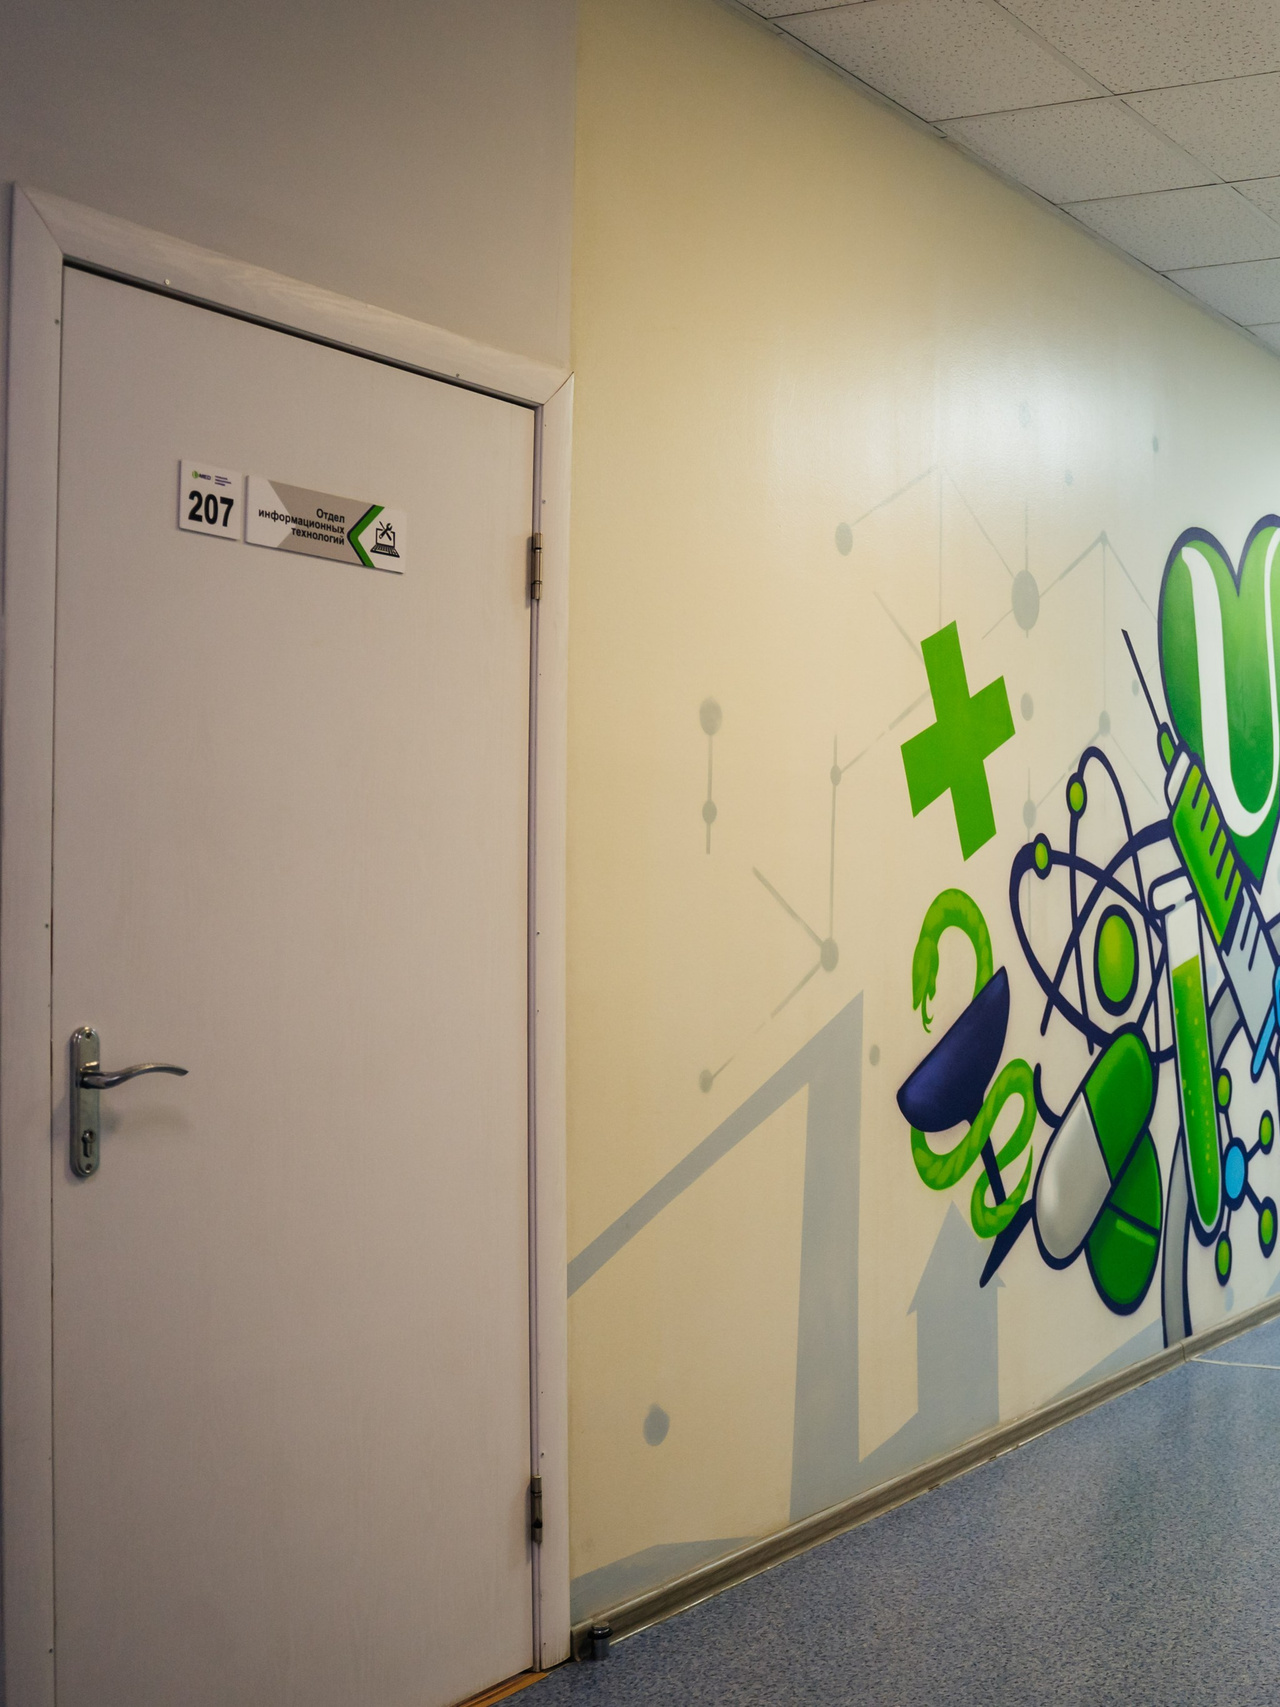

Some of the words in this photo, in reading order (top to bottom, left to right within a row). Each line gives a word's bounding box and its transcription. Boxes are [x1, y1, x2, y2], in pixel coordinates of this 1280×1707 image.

[188, 490, 234, 527] 207
[316, 508, 345, 523] Отдел
[258, 509, 345, 534] информационных
[291, 527, 345, 545] технологий
